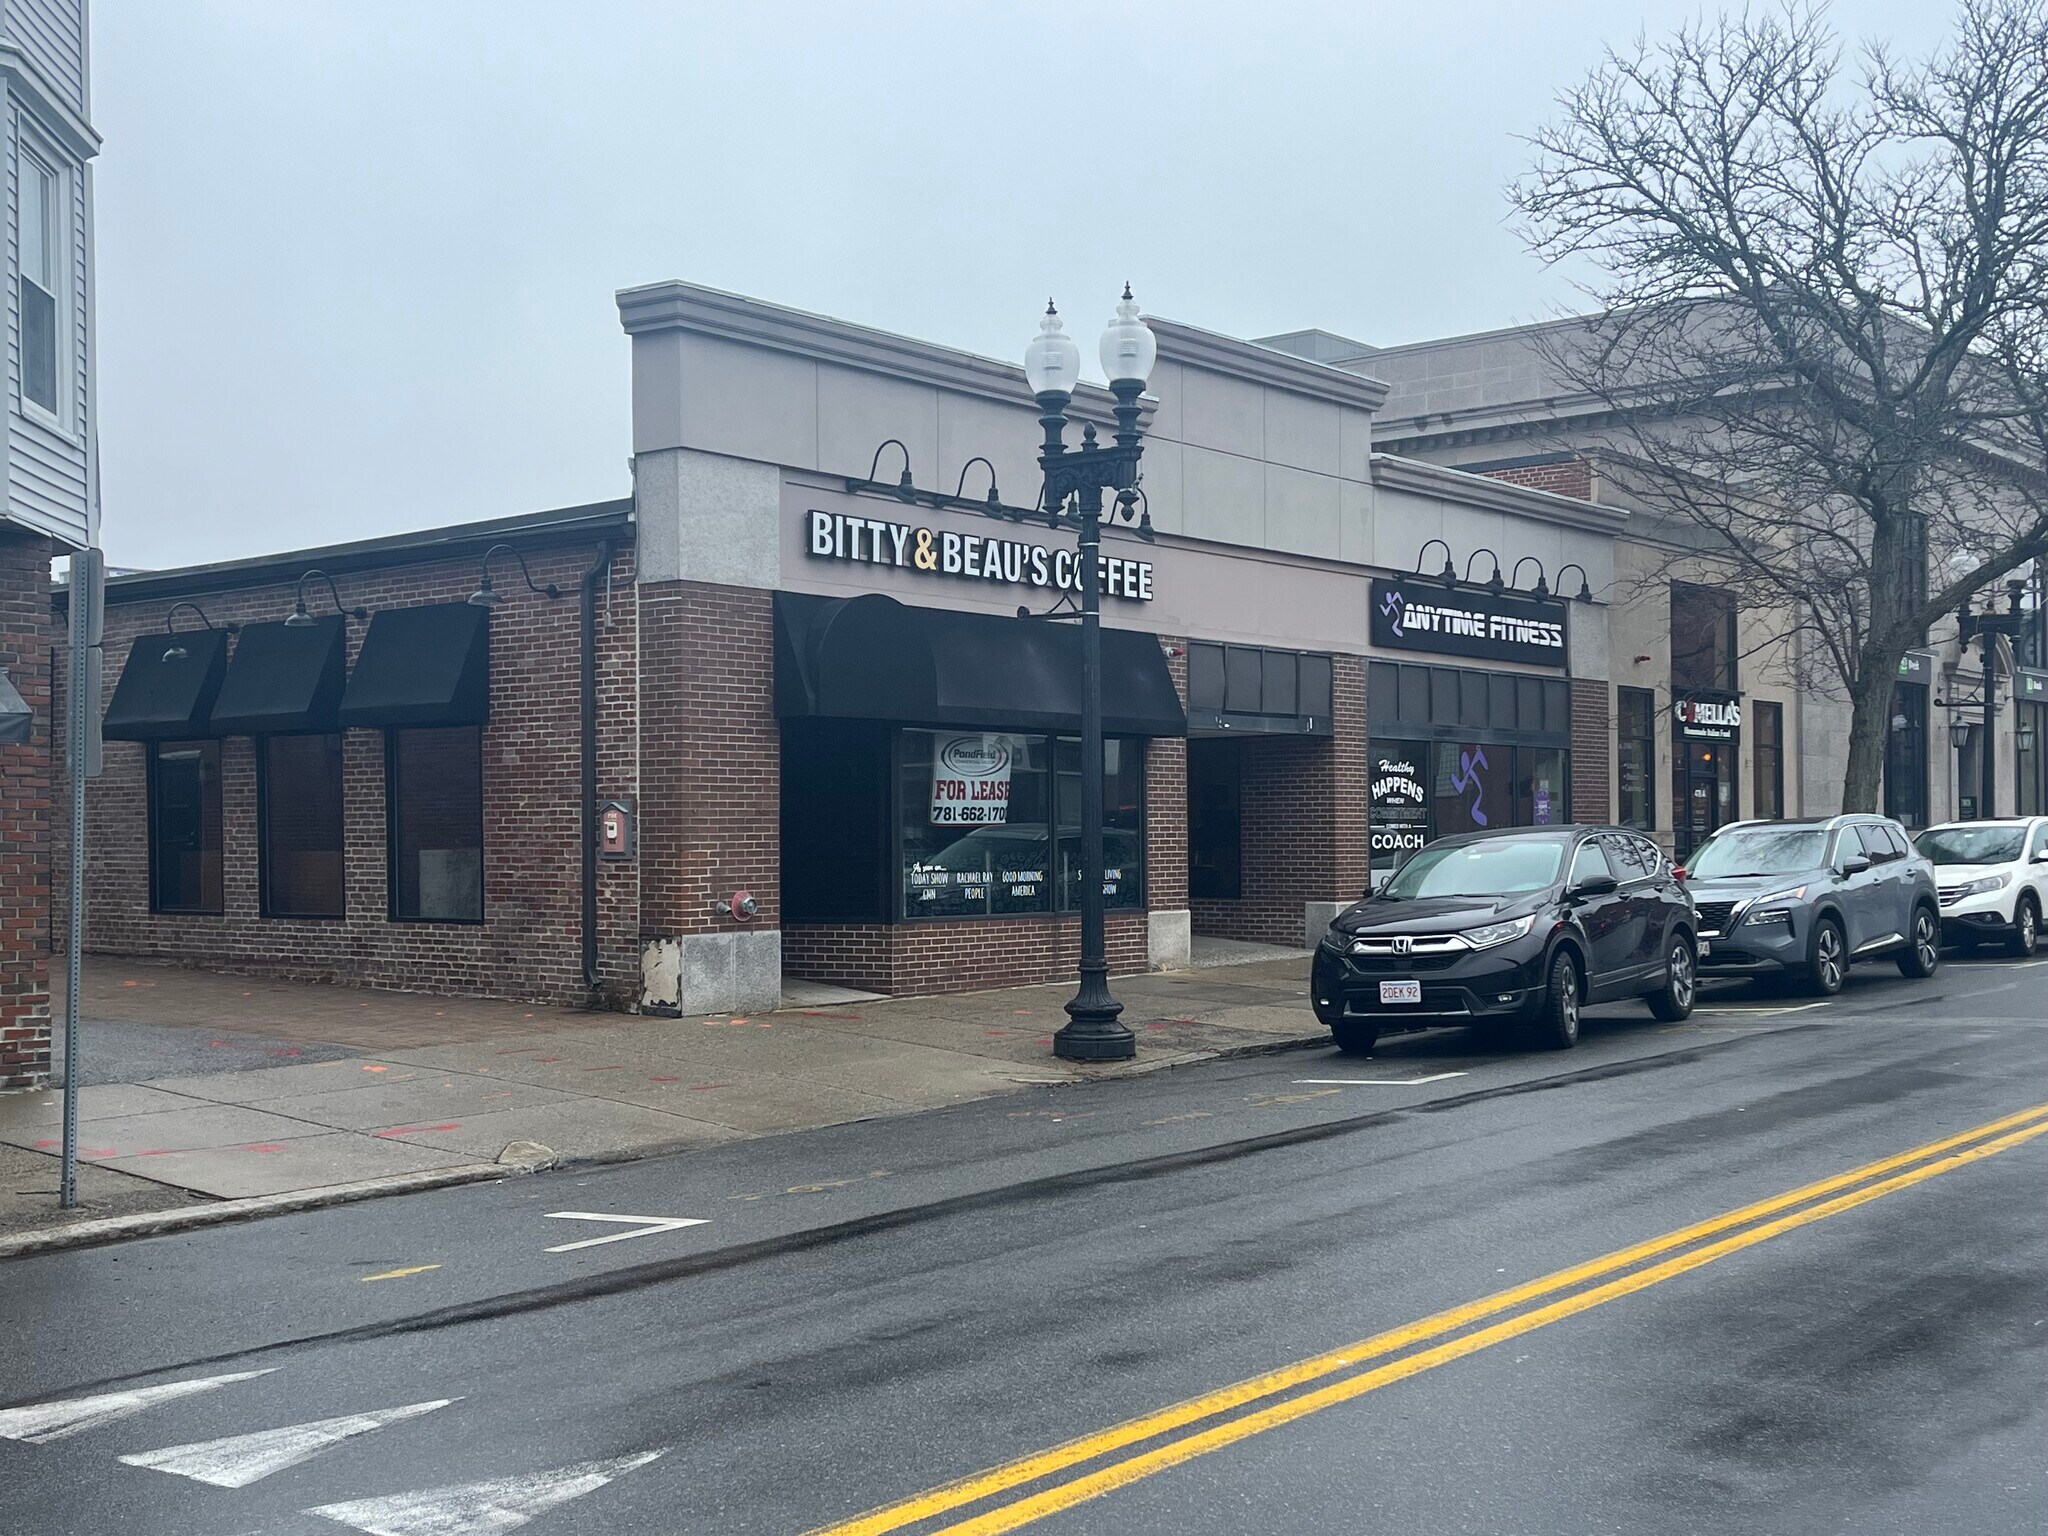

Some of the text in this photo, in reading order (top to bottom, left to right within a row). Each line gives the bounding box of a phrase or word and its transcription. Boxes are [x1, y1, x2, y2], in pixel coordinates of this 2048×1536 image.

[811, 510, 910, 567] BITTY
[913, 528, 938, 571] &
[942, 531, 1049, 587] BEAU'S
[1402, 602, 1563, 648] ANYTIME FITNESS
[1378, 759, 1416, 777] Healthy
[934, 780, 967, 801] FOR
[1371, 776, 1425, 803] HAPPENS
[1386, 797, 1406, 805] WHEN
[1371, 834, 1425, 850] COACH
[911, 872, 949, 885] TODAY SHOW
[956, 871, 994, 884] RACHAEL RAY
[1002, 870, 1043, 883] GOOD MORNING
[964, 887, 985, 899] PEOPLE
[1011, 884, 1035, 897] AMERICA
[1382, 986, 1418, 999] 2DEK 92
